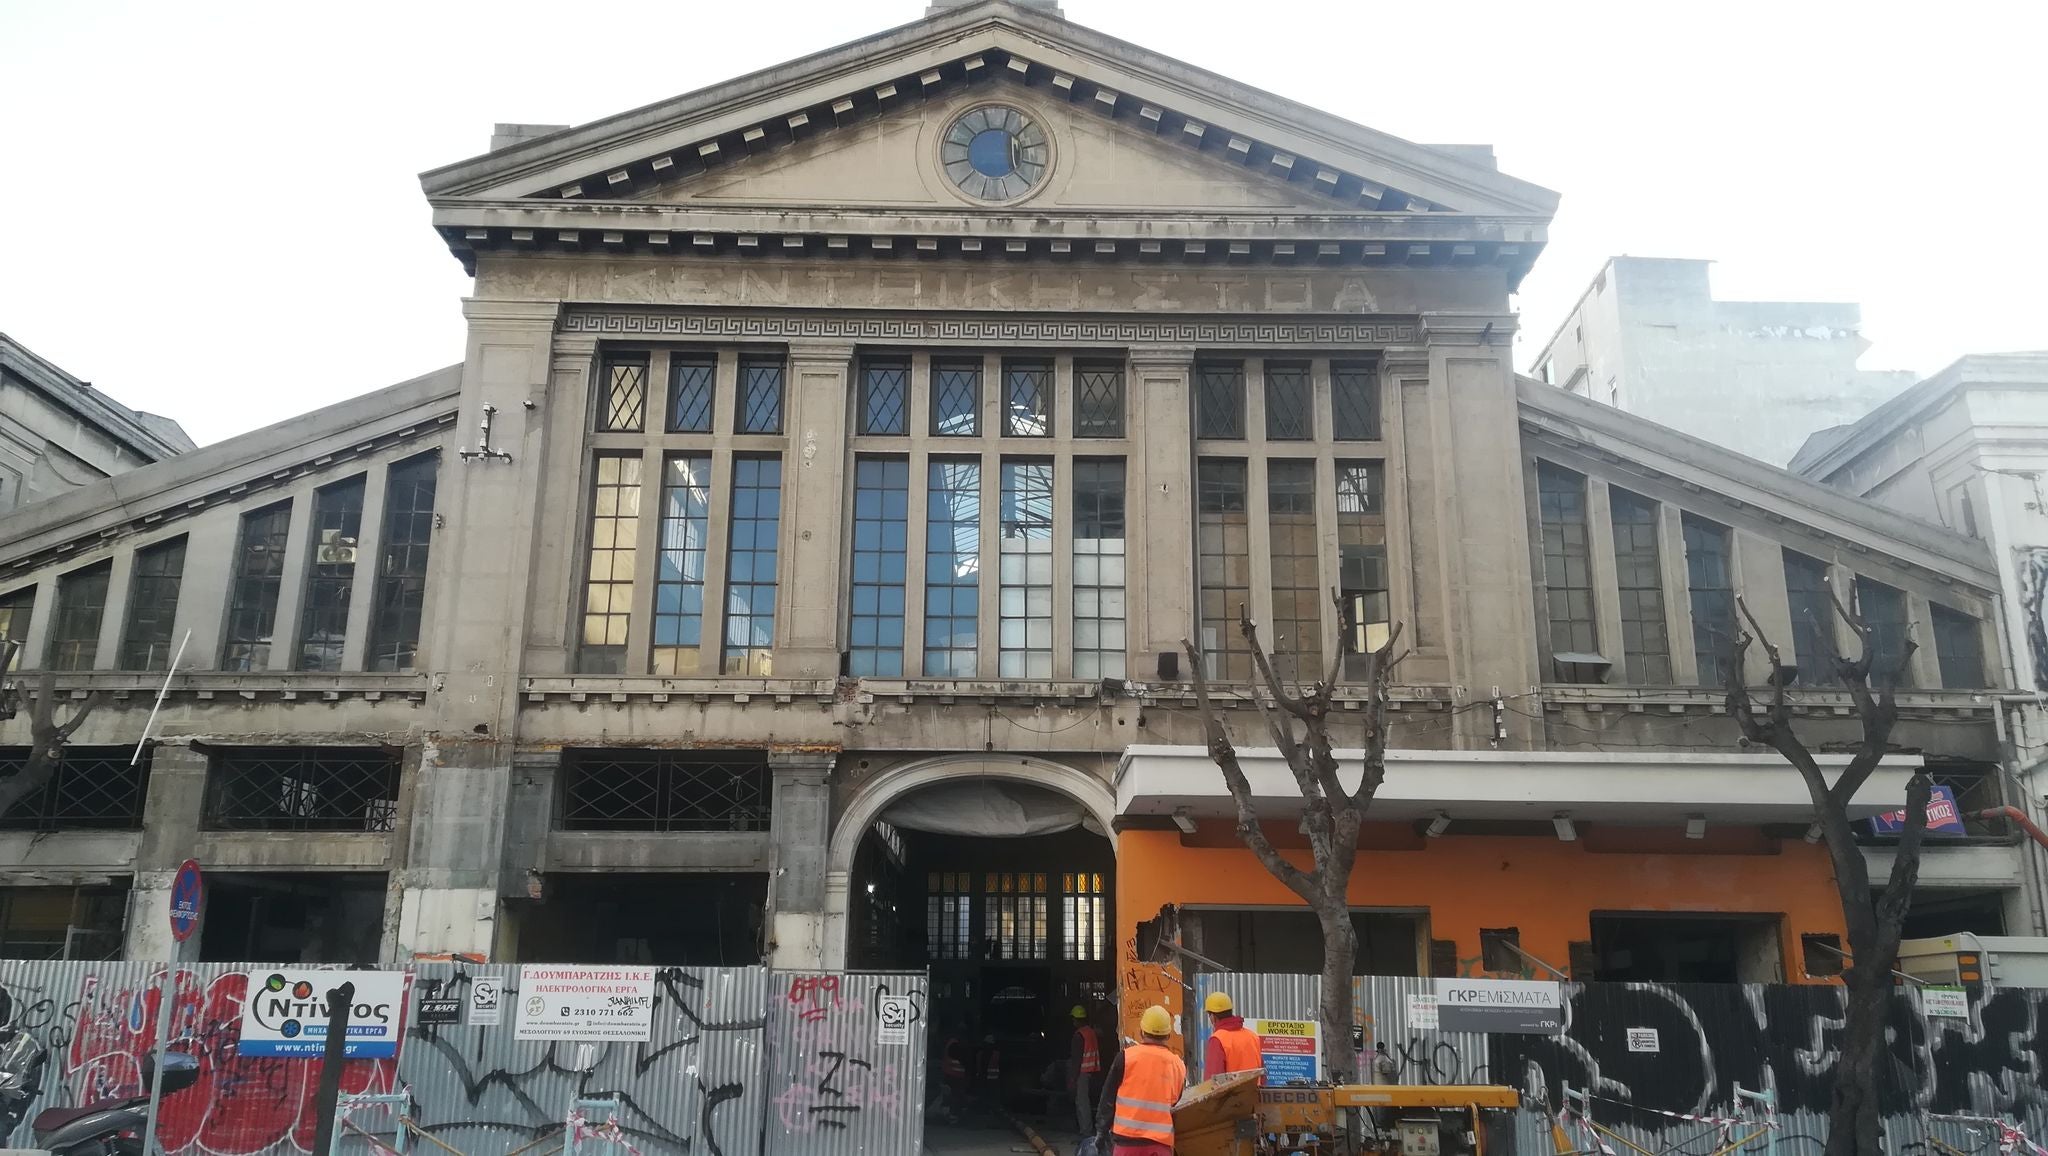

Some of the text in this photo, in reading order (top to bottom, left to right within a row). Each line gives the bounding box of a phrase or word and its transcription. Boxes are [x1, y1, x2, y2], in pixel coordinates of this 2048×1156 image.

[523, 970, 622, 980] Γ.ΔΟΥΜΠΑΡΑΤΖΗΣ
[474, 982, 498, 1005] S4
[535, 985, 638, 993] ΗΛΕΚΤΡΟΛΟΓΙΚΑ ΕΡΓΑ
[268, 996, 390, 1023] Ντίνος
[882, 1002, 905, 1024] S4
[365, 1027, 383, 1035] ΕΡΓΑ
[275, 1043, 358, 1054] www.ntin.gr
